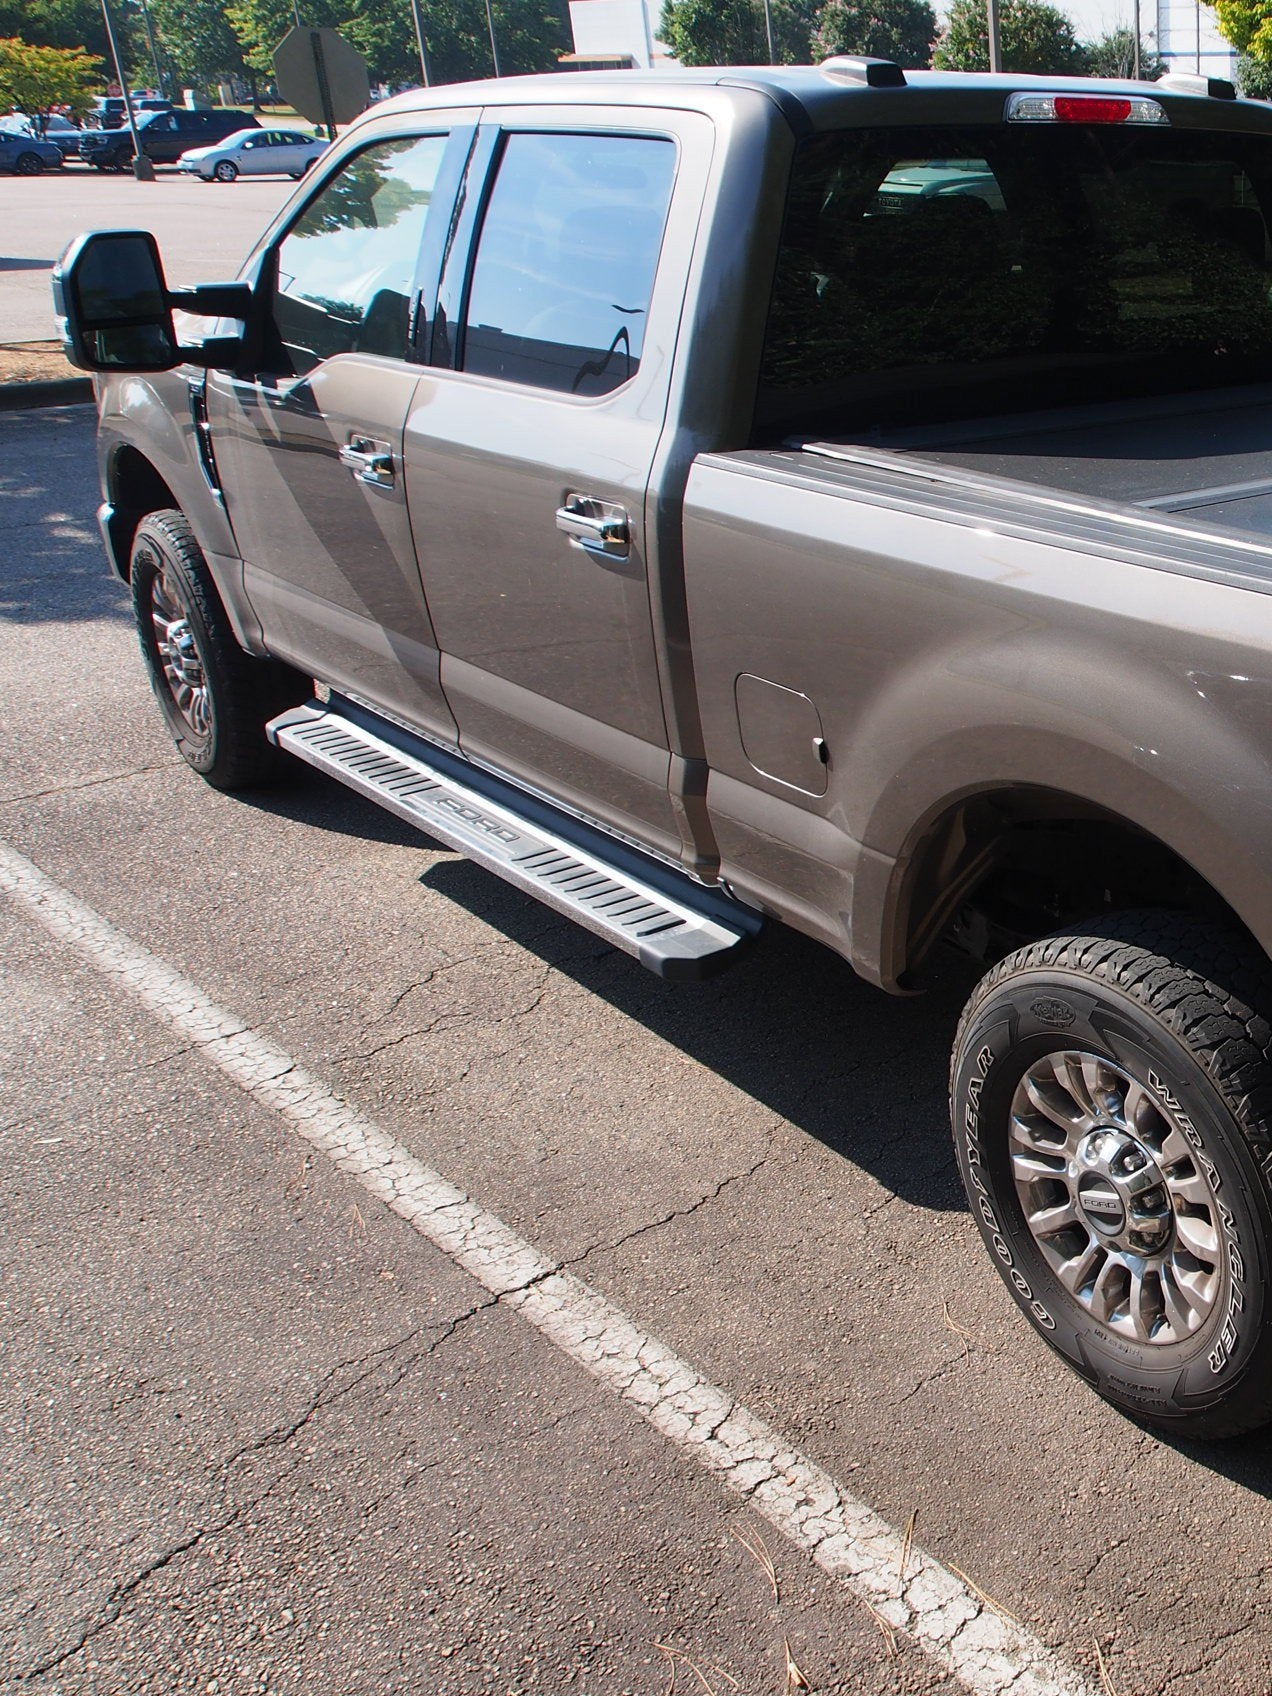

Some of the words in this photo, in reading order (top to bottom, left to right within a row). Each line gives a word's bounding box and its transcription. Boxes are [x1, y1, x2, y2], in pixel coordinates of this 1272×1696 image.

[437, 797, 521, 844] FORD
[964, 1044, 1057, 1331] GOODYEAR
[1083, 1198, 1118, 1210] FORD
[1147, 1066, 1245, 1374] WRANGLER
